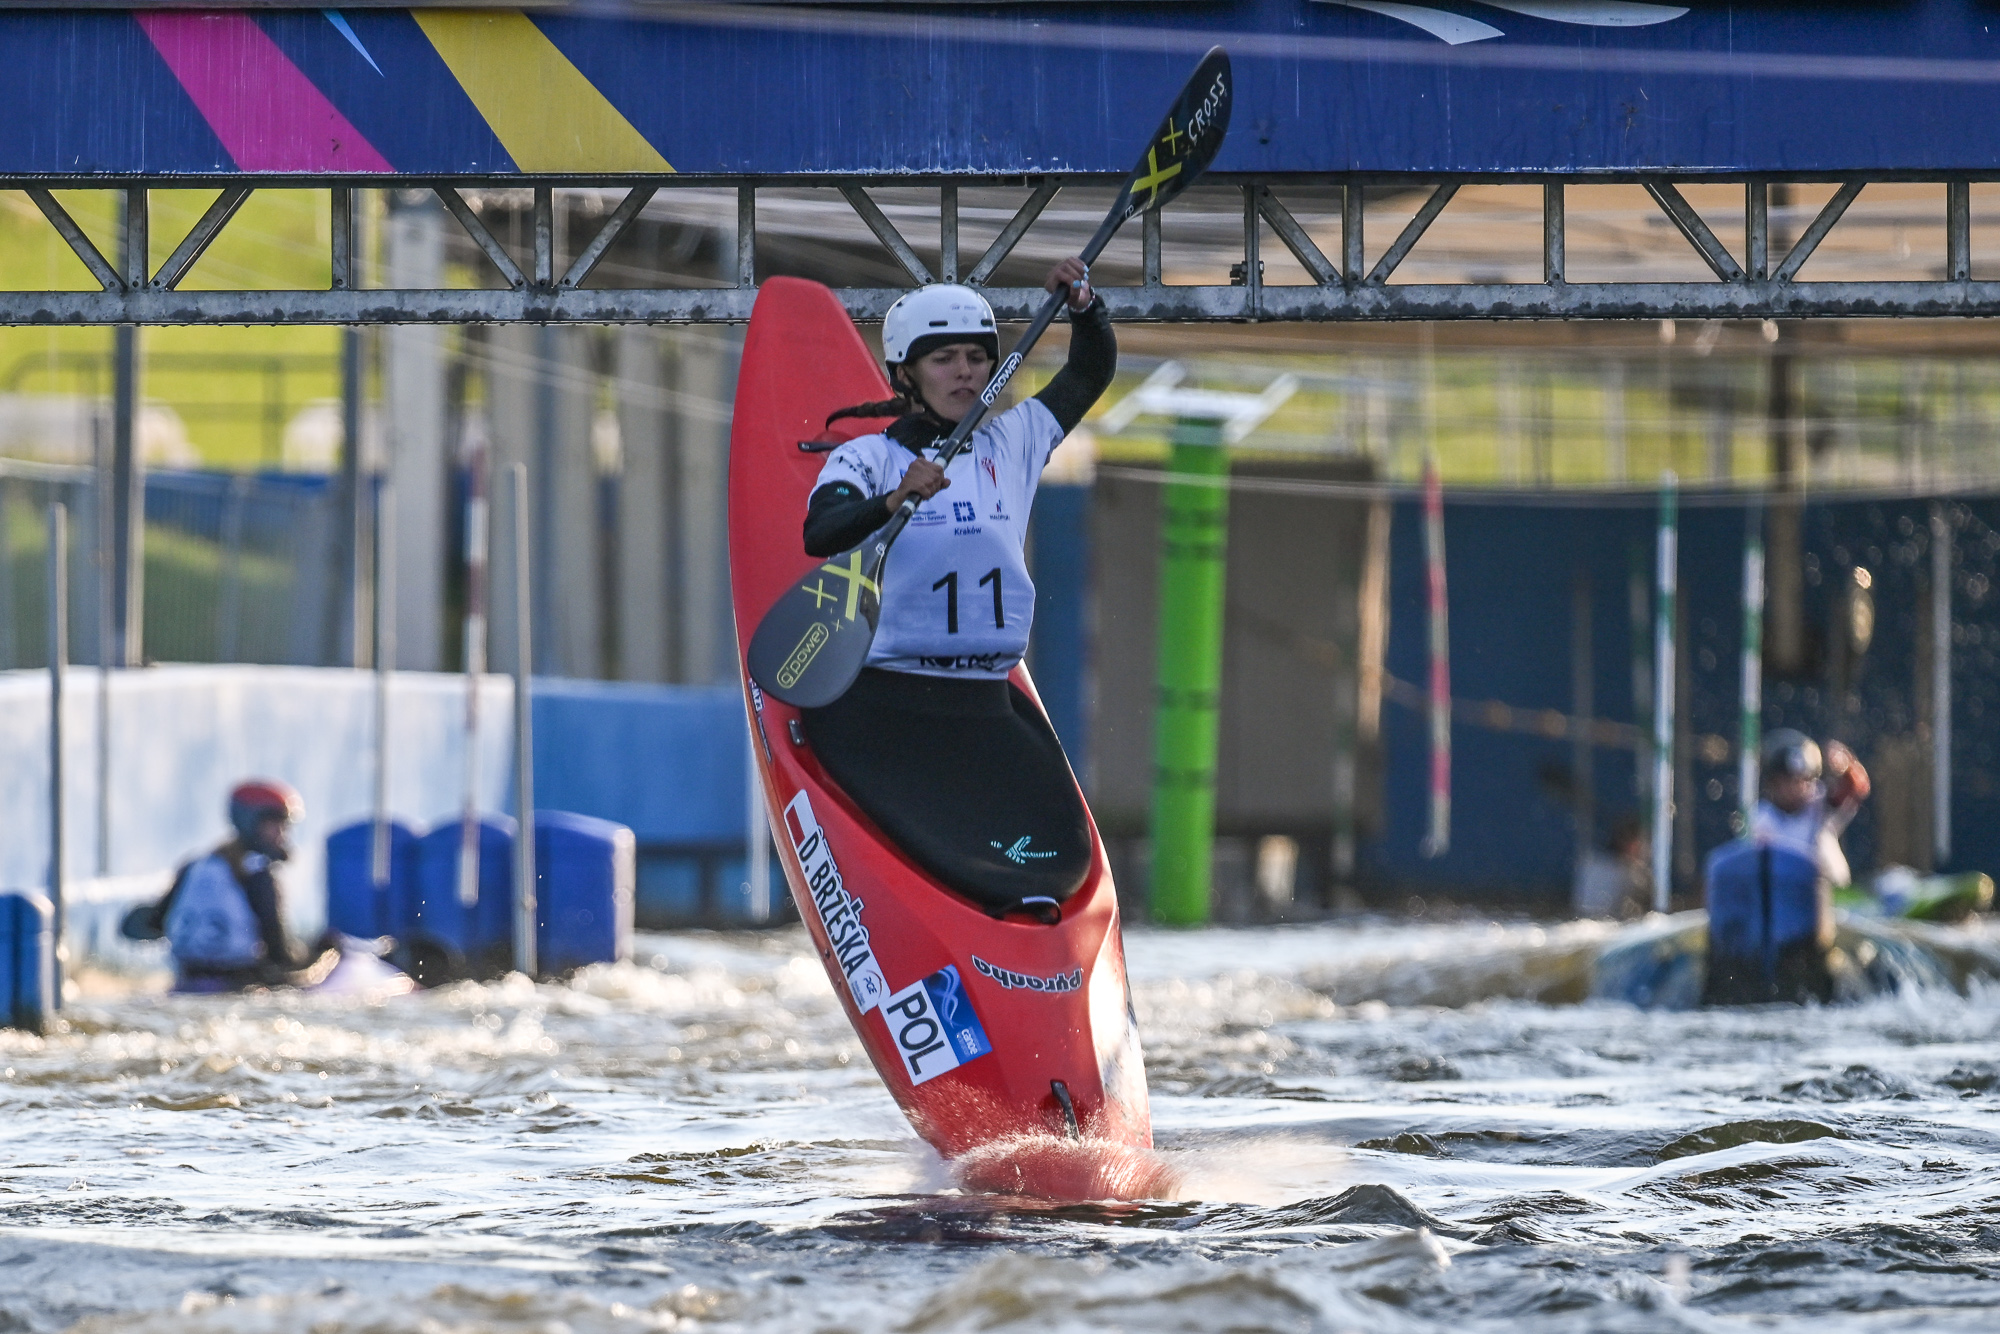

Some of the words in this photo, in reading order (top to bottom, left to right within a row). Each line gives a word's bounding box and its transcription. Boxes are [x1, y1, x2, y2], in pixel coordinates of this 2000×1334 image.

[1188, 72, 1225, 143] CROSS
[954, 526, 981, 537] Kraków
[932, 567, 1005, 635] 11
[799, 831, 820, 873] D.
[809, 860, 871, 979] BRZESKA
[971, 954, 1082, 993] pyranha
[886, 990, 946, 1076] POL
[961, 1028, 978, 1055] canoe
